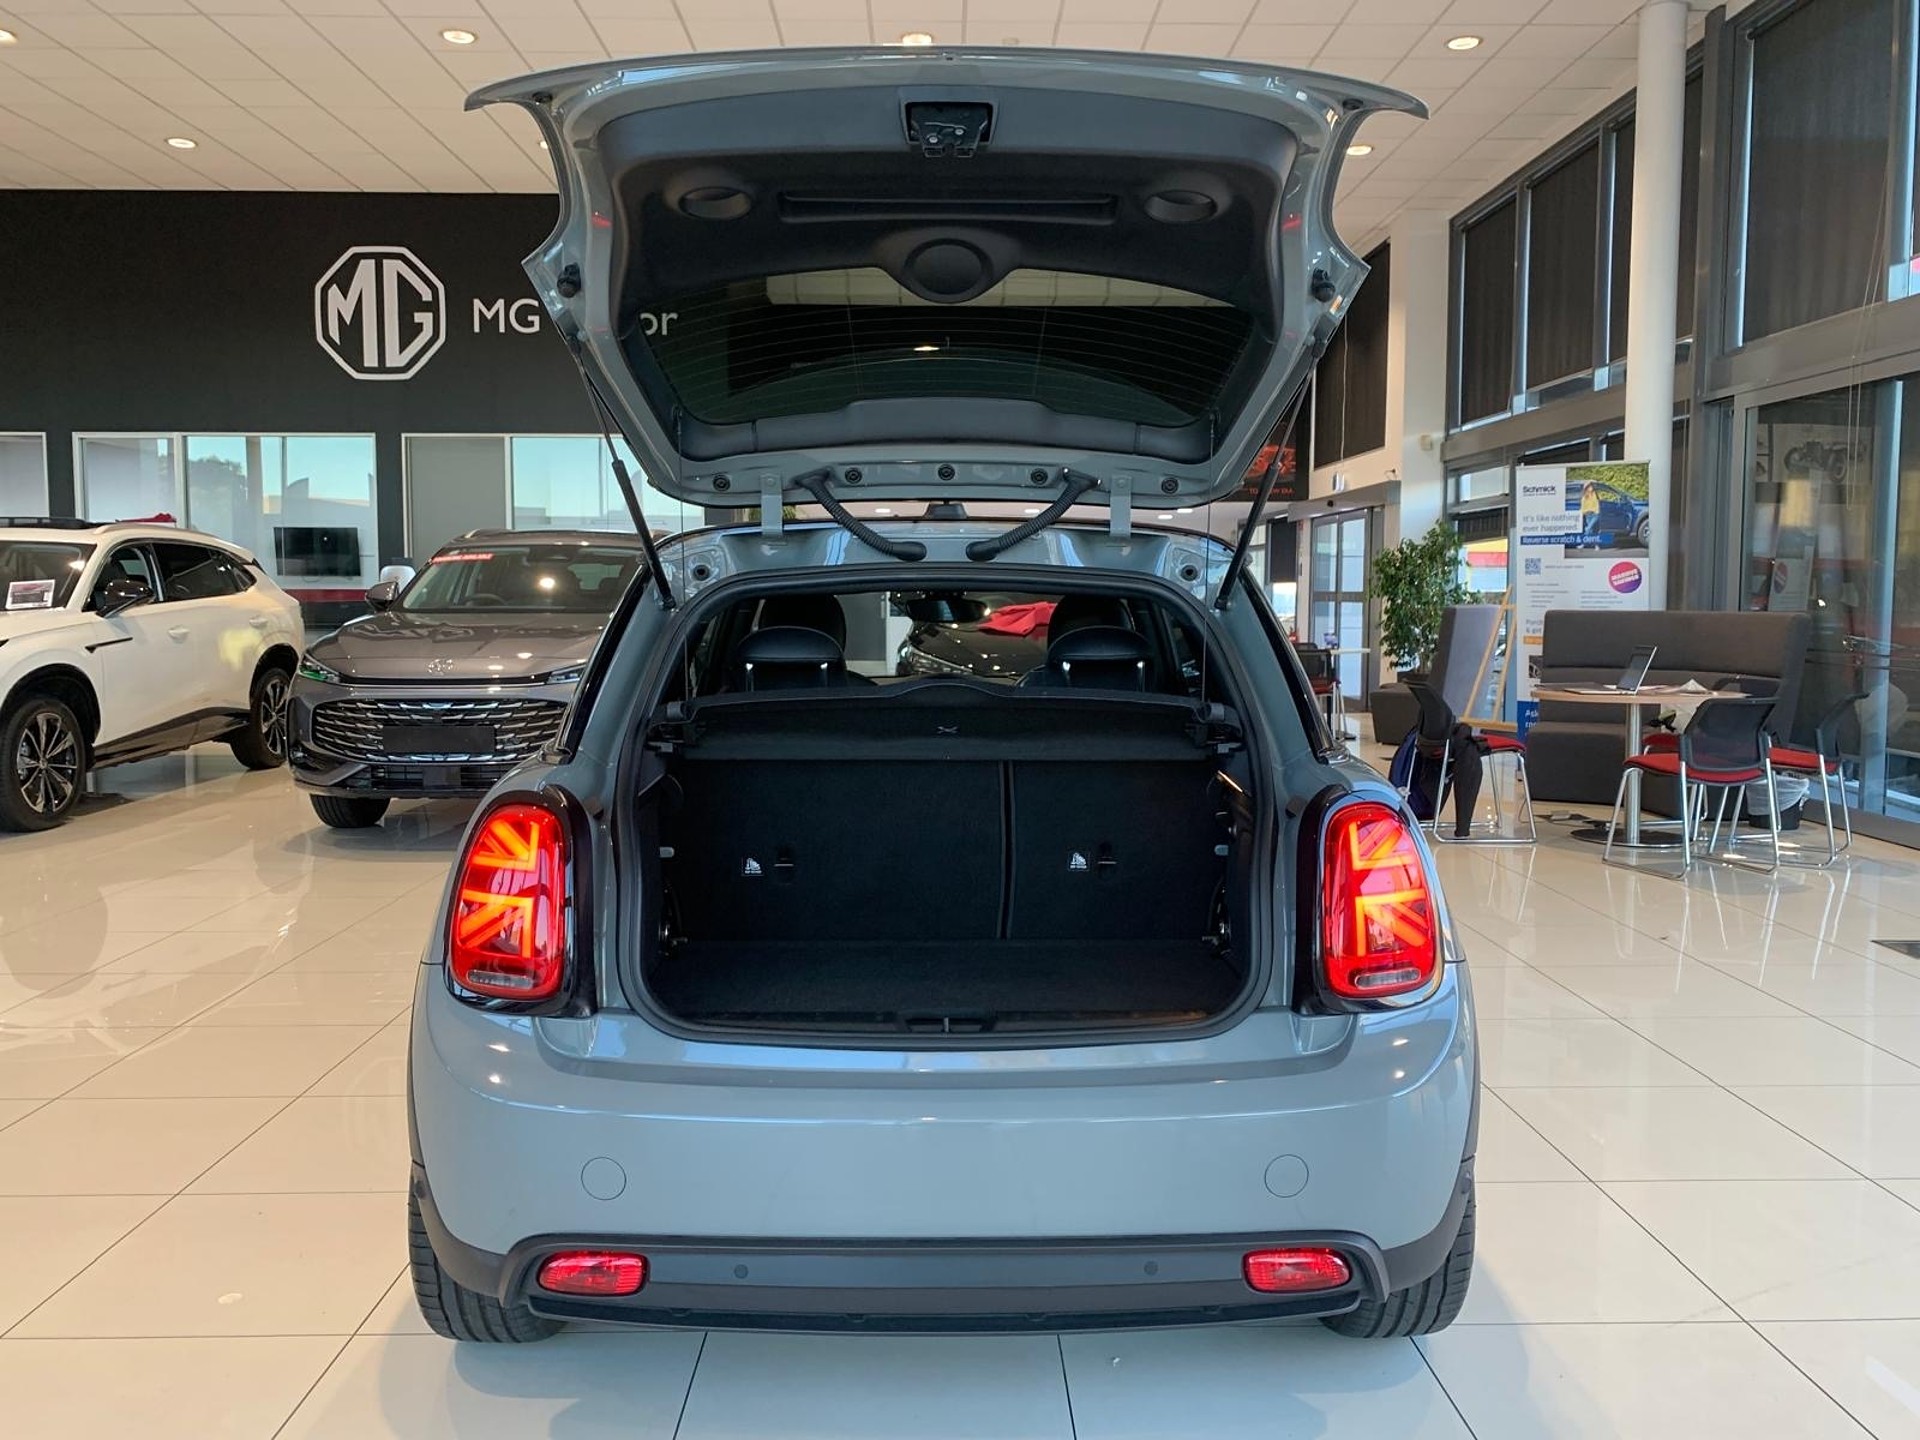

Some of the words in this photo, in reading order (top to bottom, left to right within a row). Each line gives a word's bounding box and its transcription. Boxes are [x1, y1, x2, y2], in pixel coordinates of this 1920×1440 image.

[327, 258, 433, 367] MG
[472, 298, 540, 334] MG
[1522, 485, 1556, 493] Schmick
[1536, 513, 1550, 522] like
[1551, 513, 1580, 523] nothing
[1550, 535, 1574, 543] scratch
